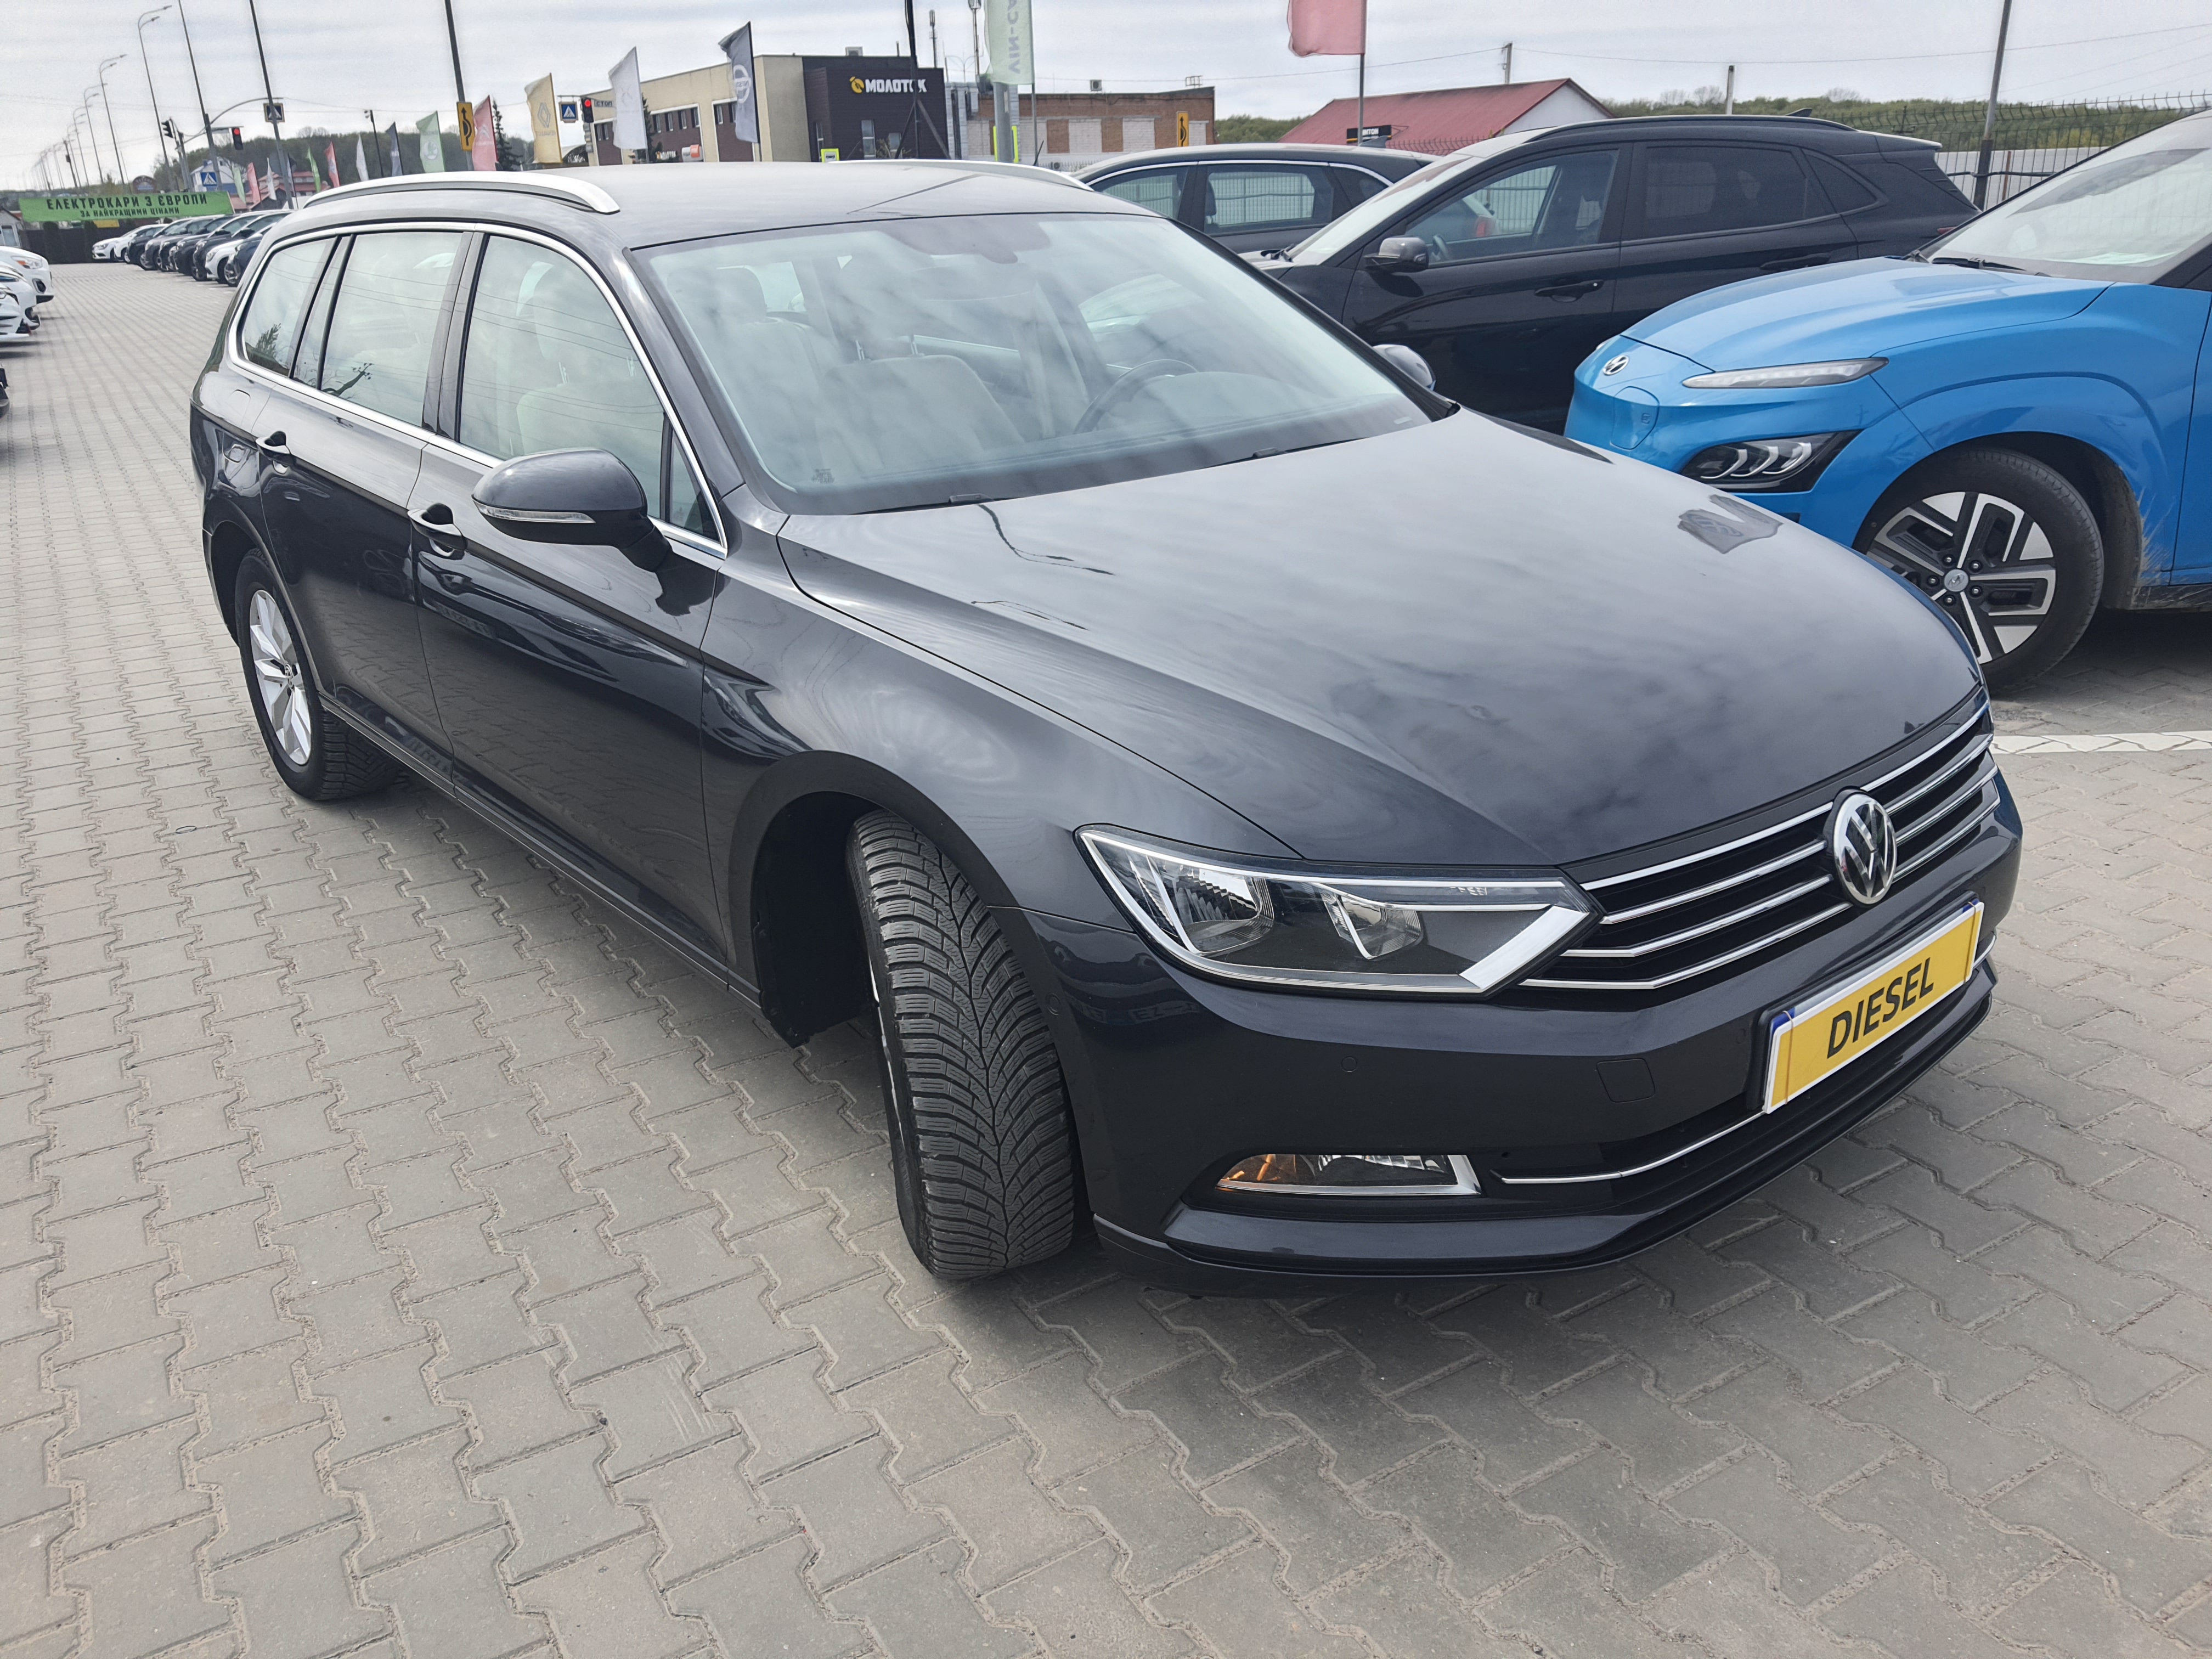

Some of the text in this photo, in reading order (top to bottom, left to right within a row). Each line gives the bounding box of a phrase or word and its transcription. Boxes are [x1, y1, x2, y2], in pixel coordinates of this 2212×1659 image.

[47, 194, 207, 210] ЕЛЕКТРОКАРИ З ЄВРОПИ
[93, 208, 147, 217] НАЙКРАЩИМИ
[1827, 957, 1934, 1059] DIESEL
